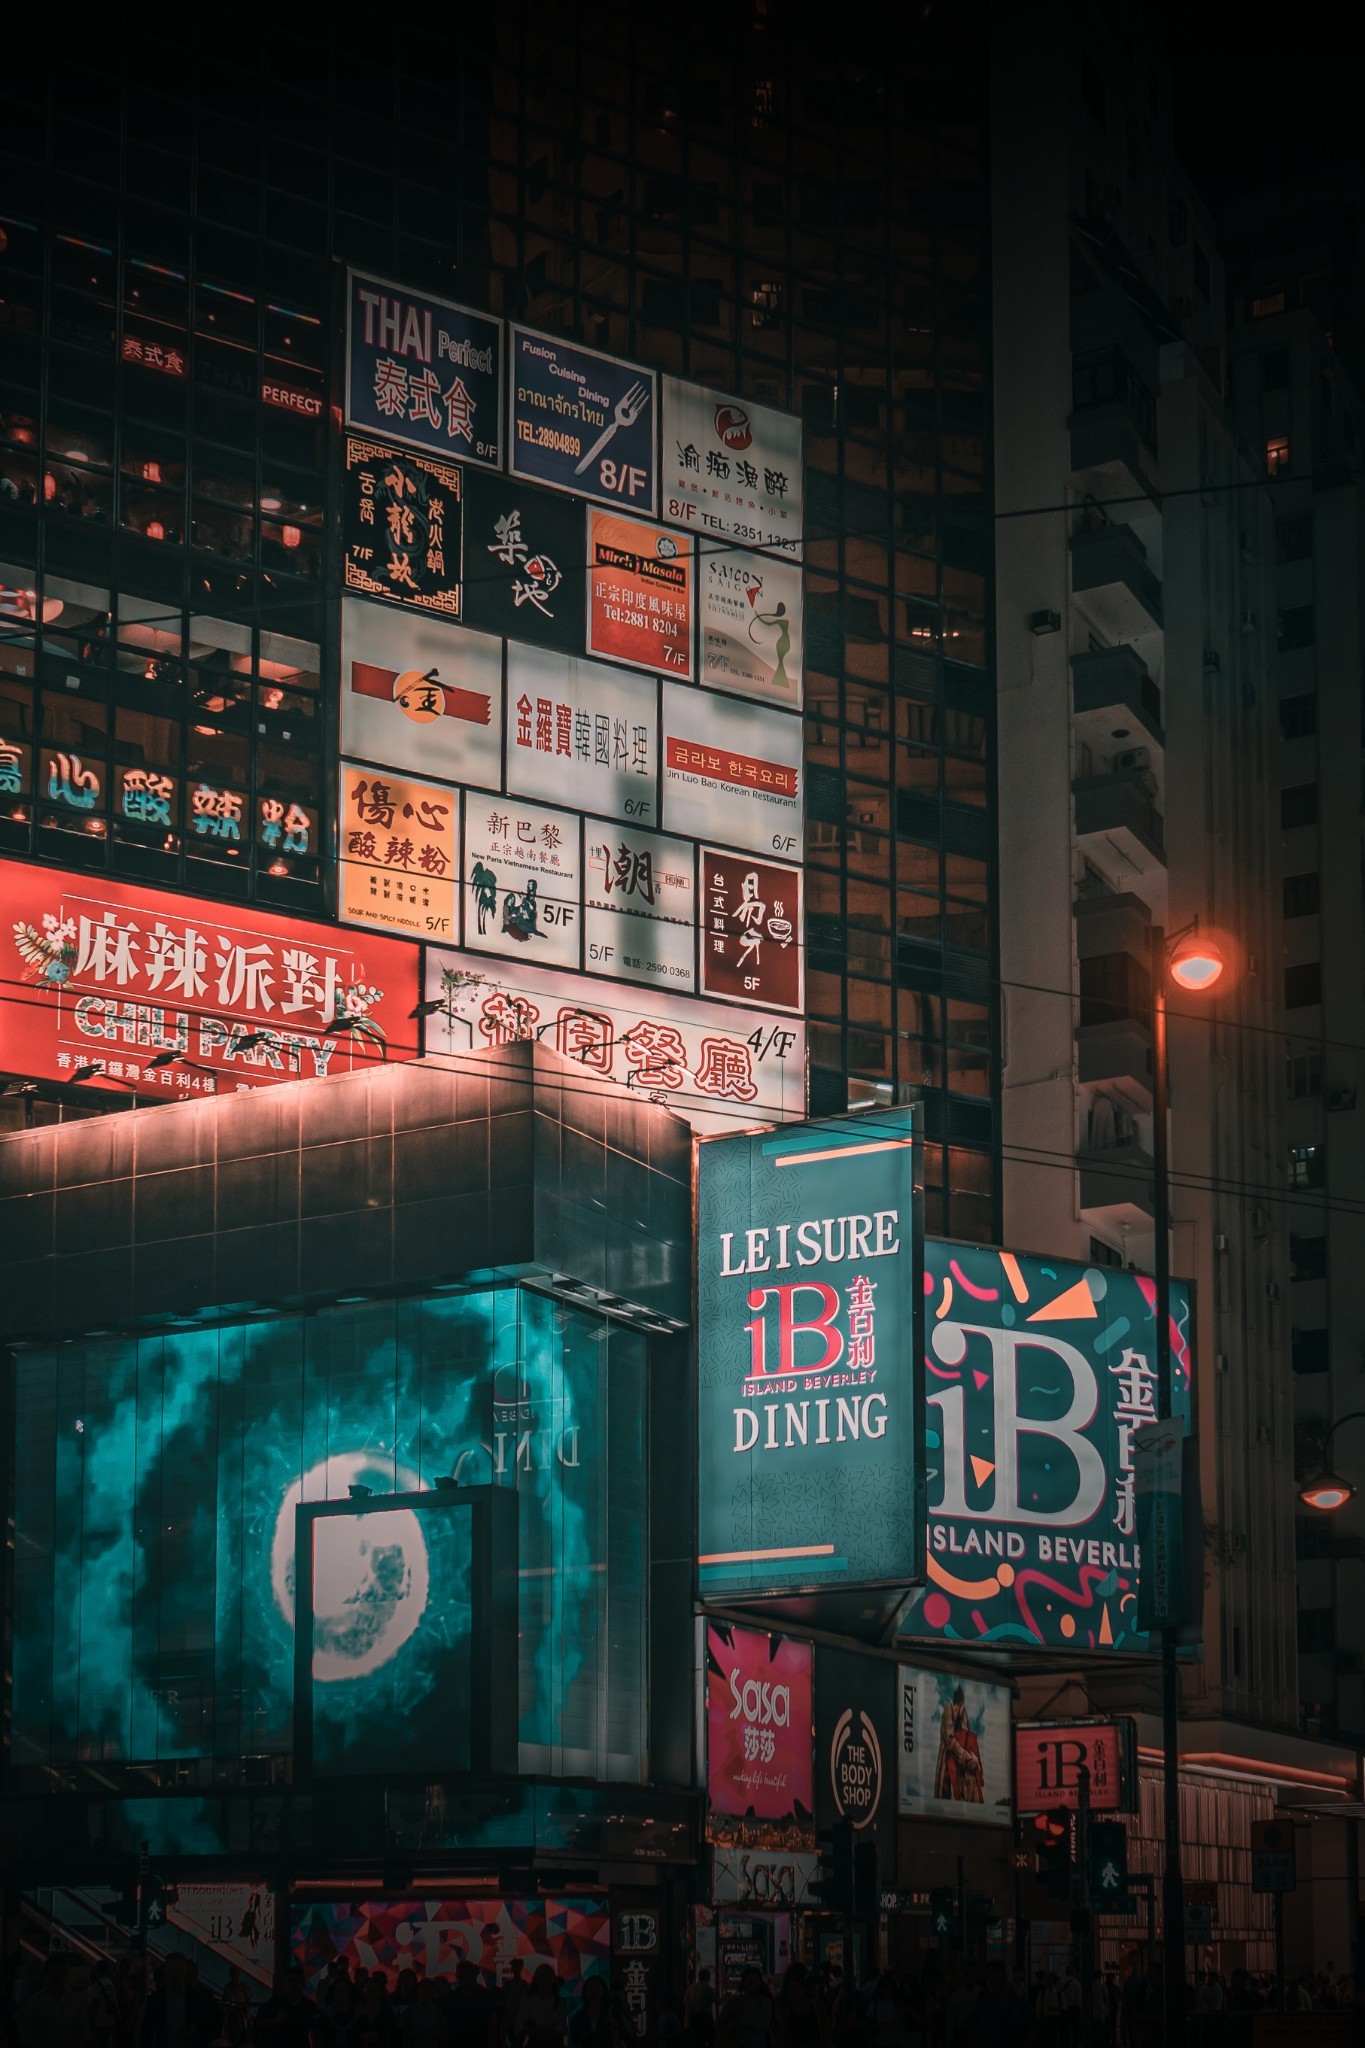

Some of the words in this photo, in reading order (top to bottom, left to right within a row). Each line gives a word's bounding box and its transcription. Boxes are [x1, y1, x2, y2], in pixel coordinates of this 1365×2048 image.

[358, 288, 432, 364] THAI
[438, 329, 492, 374] Perfect
[522, 340, 557, 361] Fusion
[549, 363, 587, 384] Cuisine
[262, 384, 322, 414] PERFECT
[373, 356, 477, 444] 泰式食
[517, 386, 604, 427] อาณาจักรไทย
[578, 386, 609, 408] Dining
[476, 441, 497, 458] 8/F
[517, 419, 581, 458] TEL:28904899
[600, 459, 647, 496] 8/F
[668, 499, 697, 520] 8/F
[701, 512, 730, 532] TEL:
[733, 523, 762, 542] 2351
[352, 545, 374, 561] 7/F
[642, 560, 683, 582] Masala
[594, 581, 686, 622] 正宗印度風味屋
[652, 617, 677, 638] 8204
[663, 645, 685, 666] 7/F
[675, 745, 722, 773] 금라보
[728, 759, 789, 790] 한국요리
[351, 780, 449, 832] 傷心
[666, 770, 680, 781] Jin
[681, 774, 699, 786] Luo
[701, 778, 718, 790] Bao
[720, 782, 750, 798] Korean
[752, 789, 797, 809] Restaurant
[623, 798, 650, 817] 6/F
[486, 812, 563, 850] 新巴黎
[771, 834, 797, 853] 6/F
[348, 831, 451, 876] 酸辣粉
[471, 852, 486, 862] New
[486, 855, 502, 865] Paris
[504, 859, 539, 872] Vietnamese
[540, 866, 573, 880] Restaurant
[490, 842, 561, 867] 正宗越南餐廳
[347, 906, 364, 917] SOUR
[365, 910, 379, 919] AND
[379, 912, 396, 923] SPICY
[397, 916, 421, 928] NOODLE
[425, 916, 450, 932] 5/F
[543, 904, 574, 927] 5/F
[73, 910, 343, 1023] 麻辣派對
[589, 943, 614, 962] 5/F
[646, 962, 668, 974] 2590
[670, 967, 691, 979] 0368
[744, 976, 760, 991] 5F
[74, 996, 189, 1053] CHILI
[200, 1017, 338, 1077] PARTY
[746, 1025, 798, 1062] 4/F
[720, 1209, 900, 1278] LEISURE
[744, 1280, 844, 1381] iB
[845, 1274, 878, 1369] 金百利
[741, 1377, 798, 1397] ISLAND
[802, 1369, 877, 1391] BEVERLEY
[733, 1394, 889, 1454] DINING
[926, 1321, 1106, 1527] iB
[927, 1523, 1025, 1559] ISLAND
[1038, 1534, 1142, 1570] BEVERLE
[903, 1684, 917, 1754] izzue
[744, 1727, 776, 1763] 莎莎
[847, 1744, 865, 1764] THE
[841, 1766, 873, 1785] BODY
[1036, 1740, 1090, 1789] iB
[843, 1788, 871, 1807] SHOP
[1035, 1790, 1065, 1799] ISLAND
[1068, 1789, 1109, 1798] BELEY
[1257, 1857, 1272, 1868] 24
[1273, 1857, 1290, 1868] hrs
[880, 1892, 897, 1908] HOP.
[621, 1912, 657, 1951] iB
